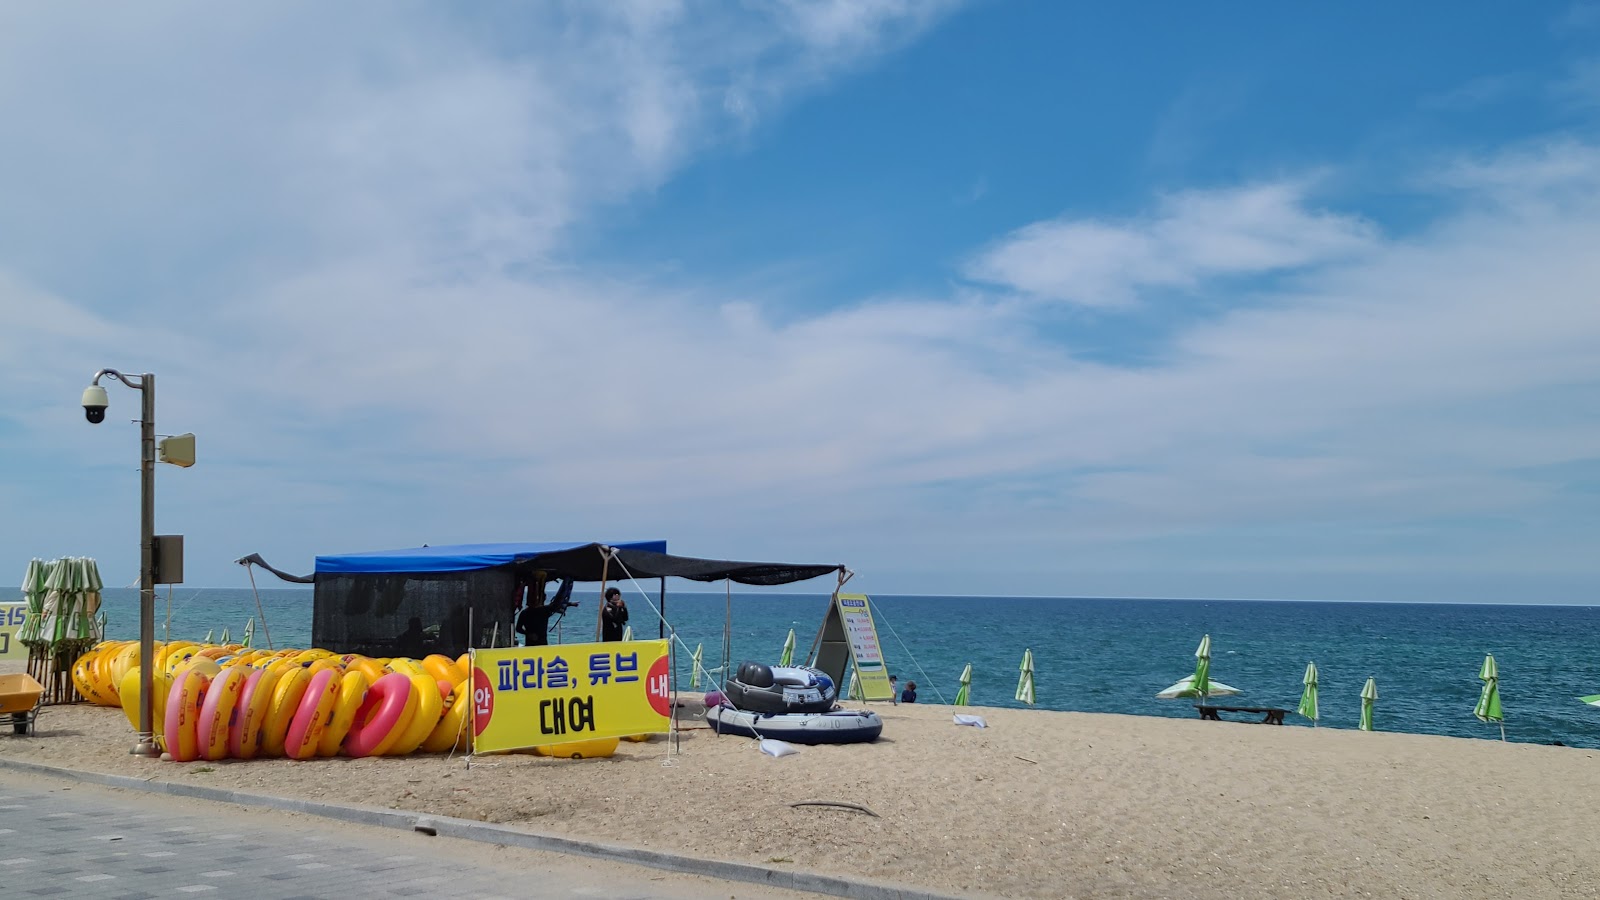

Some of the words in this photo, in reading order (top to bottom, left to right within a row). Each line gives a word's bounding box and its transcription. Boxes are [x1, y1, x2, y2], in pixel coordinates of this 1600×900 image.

[498, 655, 577, 691] 파라솔,
[589, 652, 639, 685] 튜브
[650, 674, 669, 698] 내
[475, 687, 491, 715] 안
[540, 695, 595, 735] 대여
